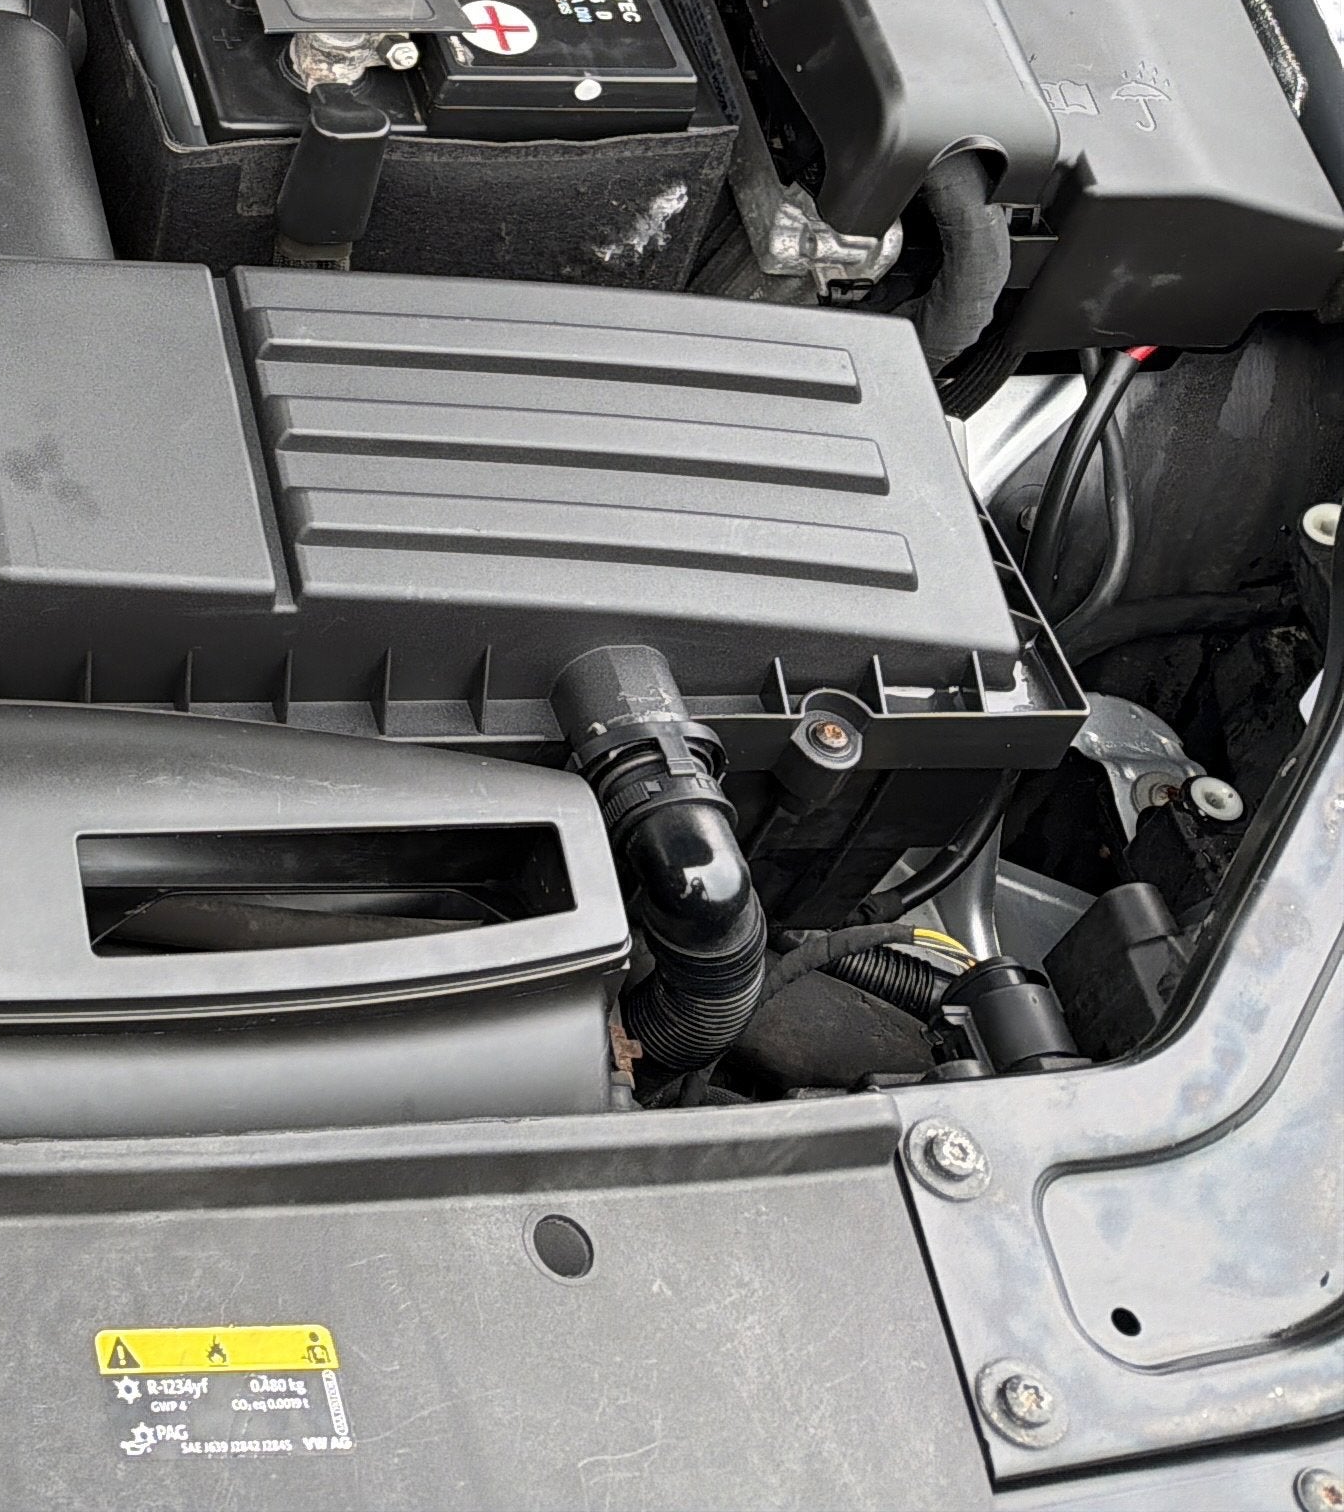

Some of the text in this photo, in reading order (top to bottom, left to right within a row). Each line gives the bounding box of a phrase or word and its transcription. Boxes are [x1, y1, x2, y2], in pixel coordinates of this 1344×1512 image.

[147, 1378, 209, 1399] R-1234yf
[288, 1378, 307, 1395] kg
[150, 1401, 178, 1413] GWP
[156, 1424, 189, 1441] PAG
[181, 1441, 202, 1454] SAE
[302, 1438, 327, 1451] VW
[331, 1437, 353, 1450] AG
